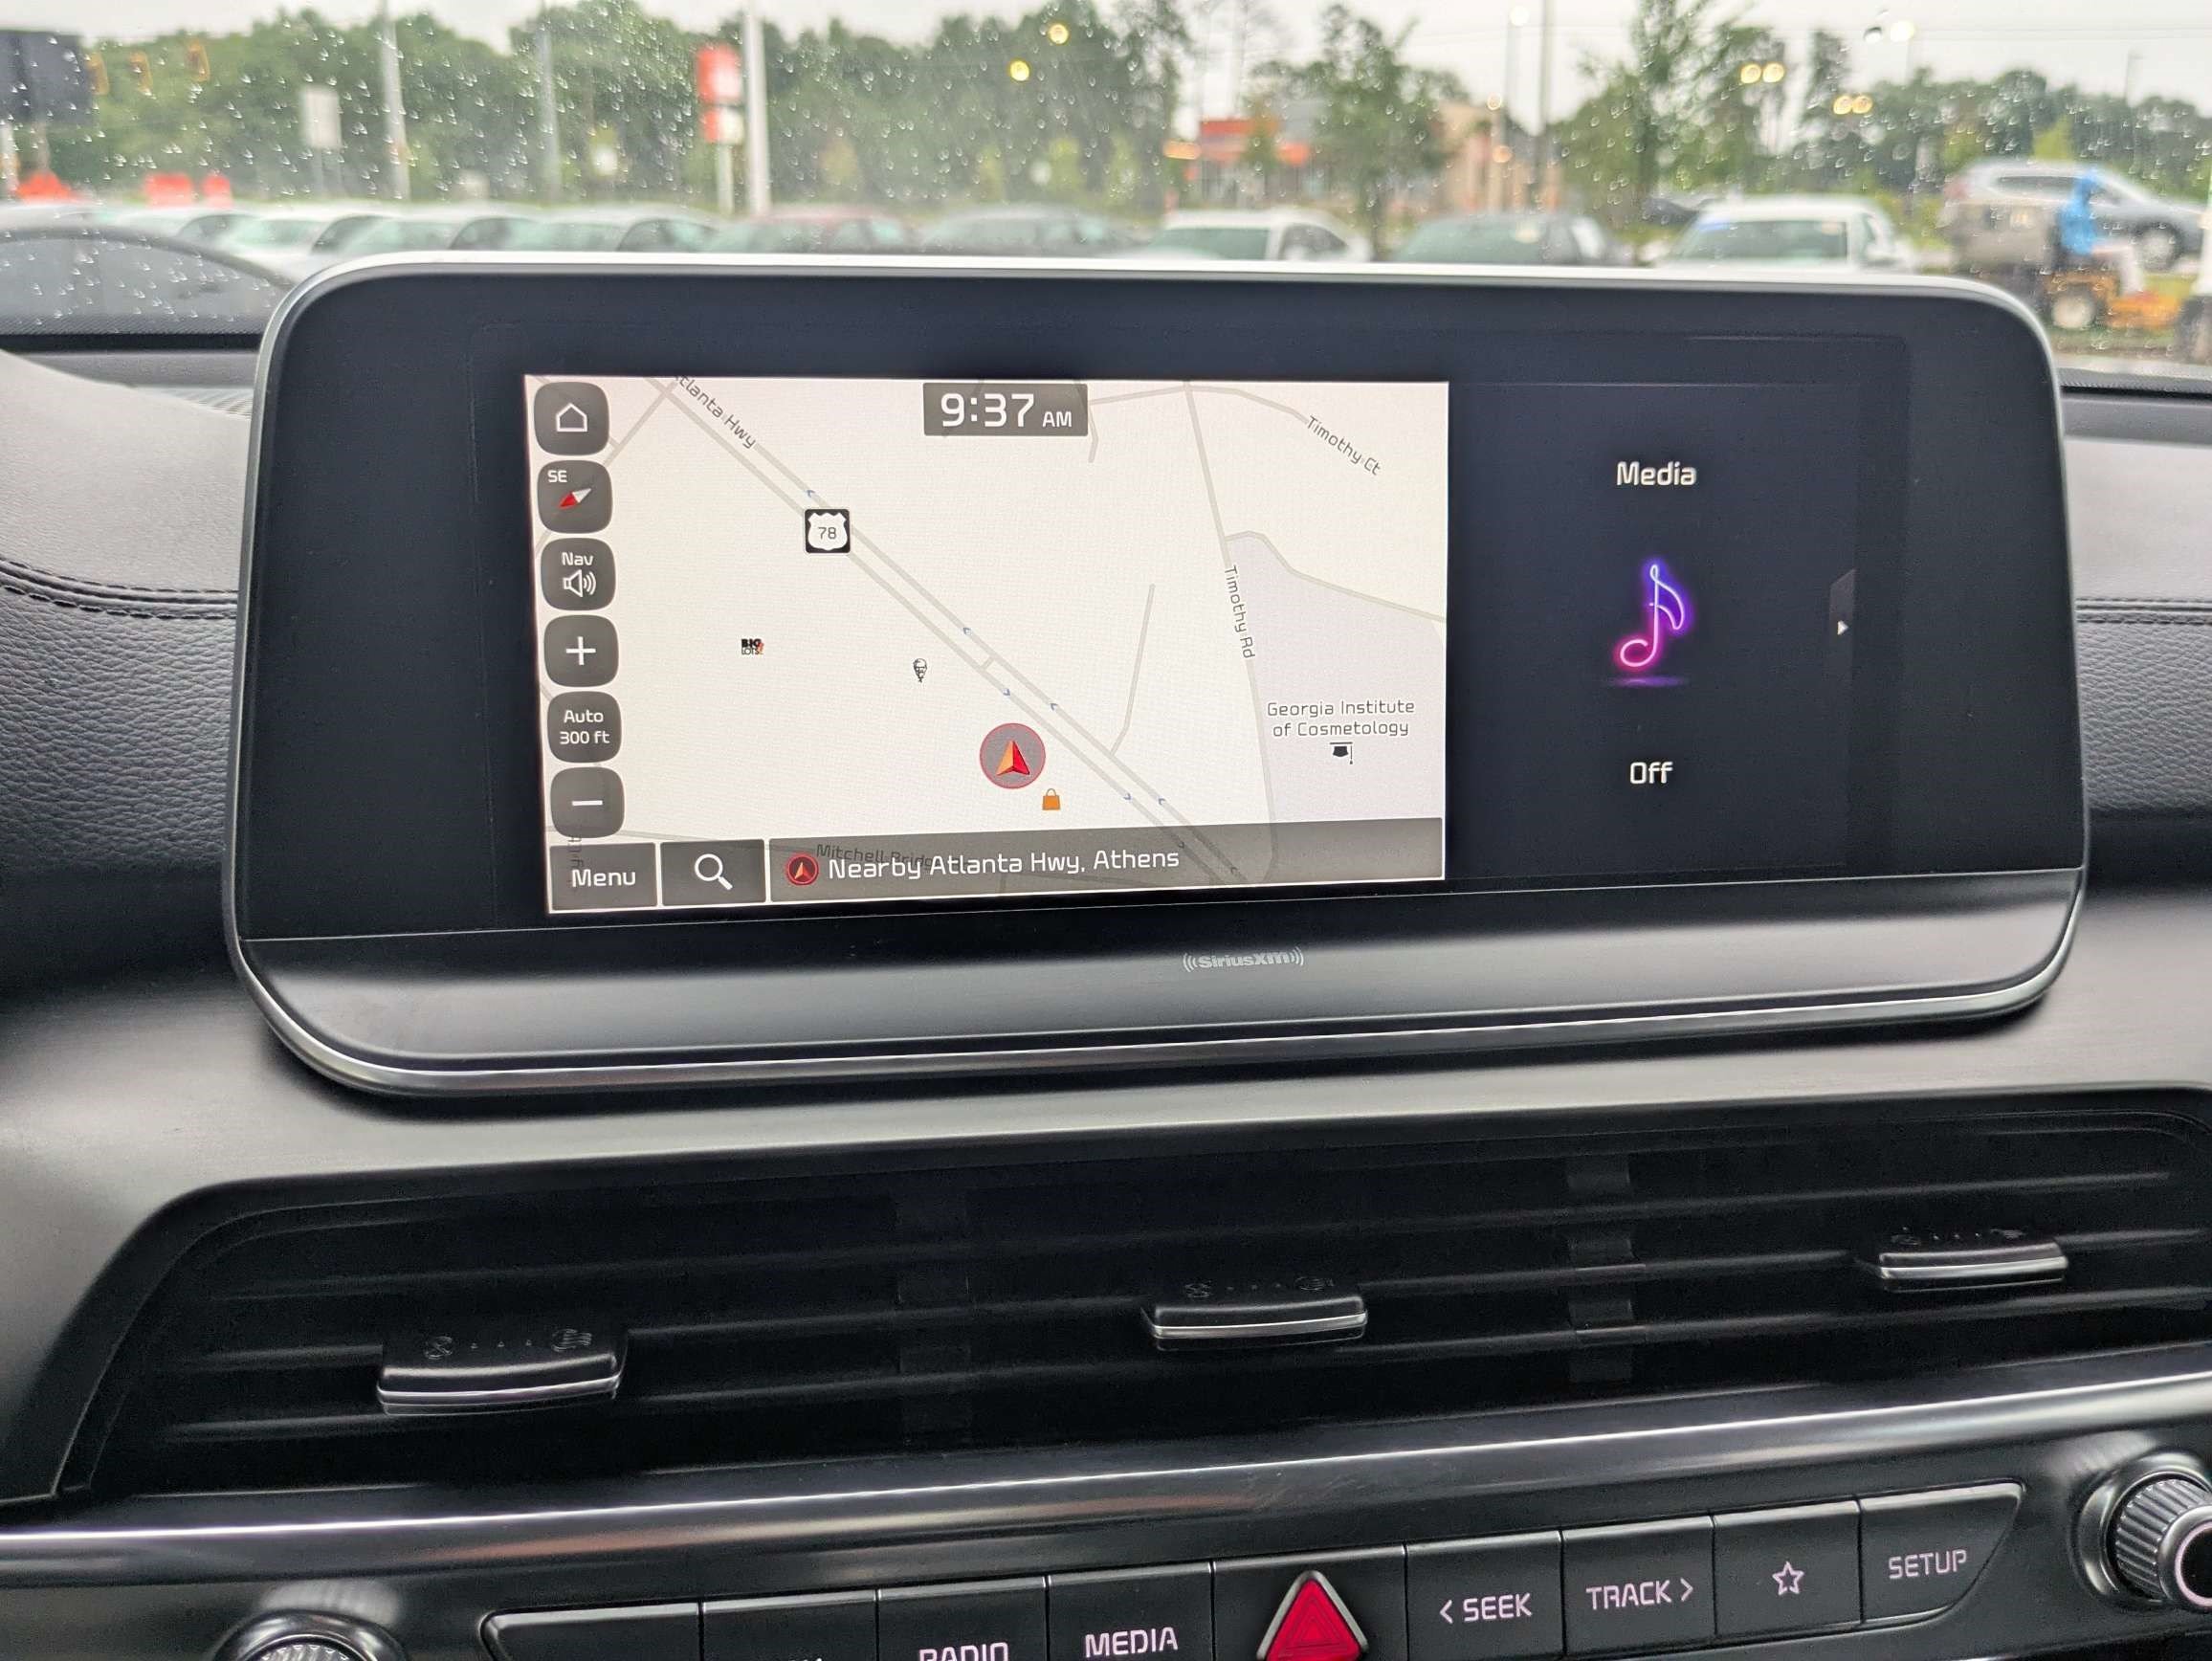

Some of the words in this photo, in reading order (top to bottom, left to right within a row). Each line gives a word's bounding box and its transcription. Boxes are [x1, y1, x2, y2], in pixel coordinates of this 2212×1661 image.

[675, 375, 724, 418] tlanta
[723, 413, 756, 450] Hwy
[940, 392, 1034, 427] 9:37
[1042, 410, 1073, 428] AM
[1307, 414, 1362, 465] Timothy
[1363, 456, 1381, 476] Ct
[547, 469, 568, 483] SE
[1616, 461, 1697, 486] Media
[818, 526, 837, 540] 78
[561, 551, 594, 566] Nav
[1225, 565, 1247, 633] Timothy
[1240, 636, 1256, 658] Rd
[564, 709, 605, 723] Auto
[1268, 701, 1335, 718] Georgia
[1340, 699, 1415, 715] Institute
[559, 730, 590, 745] 300
[594, 730, 610, 744] ft
[1272, 722, 1292, 737] of
[1297, 720, 1409, 737] Cosmetology
[1629, 762, 1673, 785] Off
[816, 844, 885, 864] Mitchell
[829, 856, 921, 880] Nearby
[929, 853, 1023, 875] Atlanta
[1094, 849, 1180, 870] Athens
[571, 869, 636, 888] Menu
[1889, 1549, 1967, 1580] SETUP
[1585, 1580, 1672, 1610] TRACK
[1462, 1592, 1533, 1623] SEEK
[1085, 1627, 1179, 1658] MEDIA
